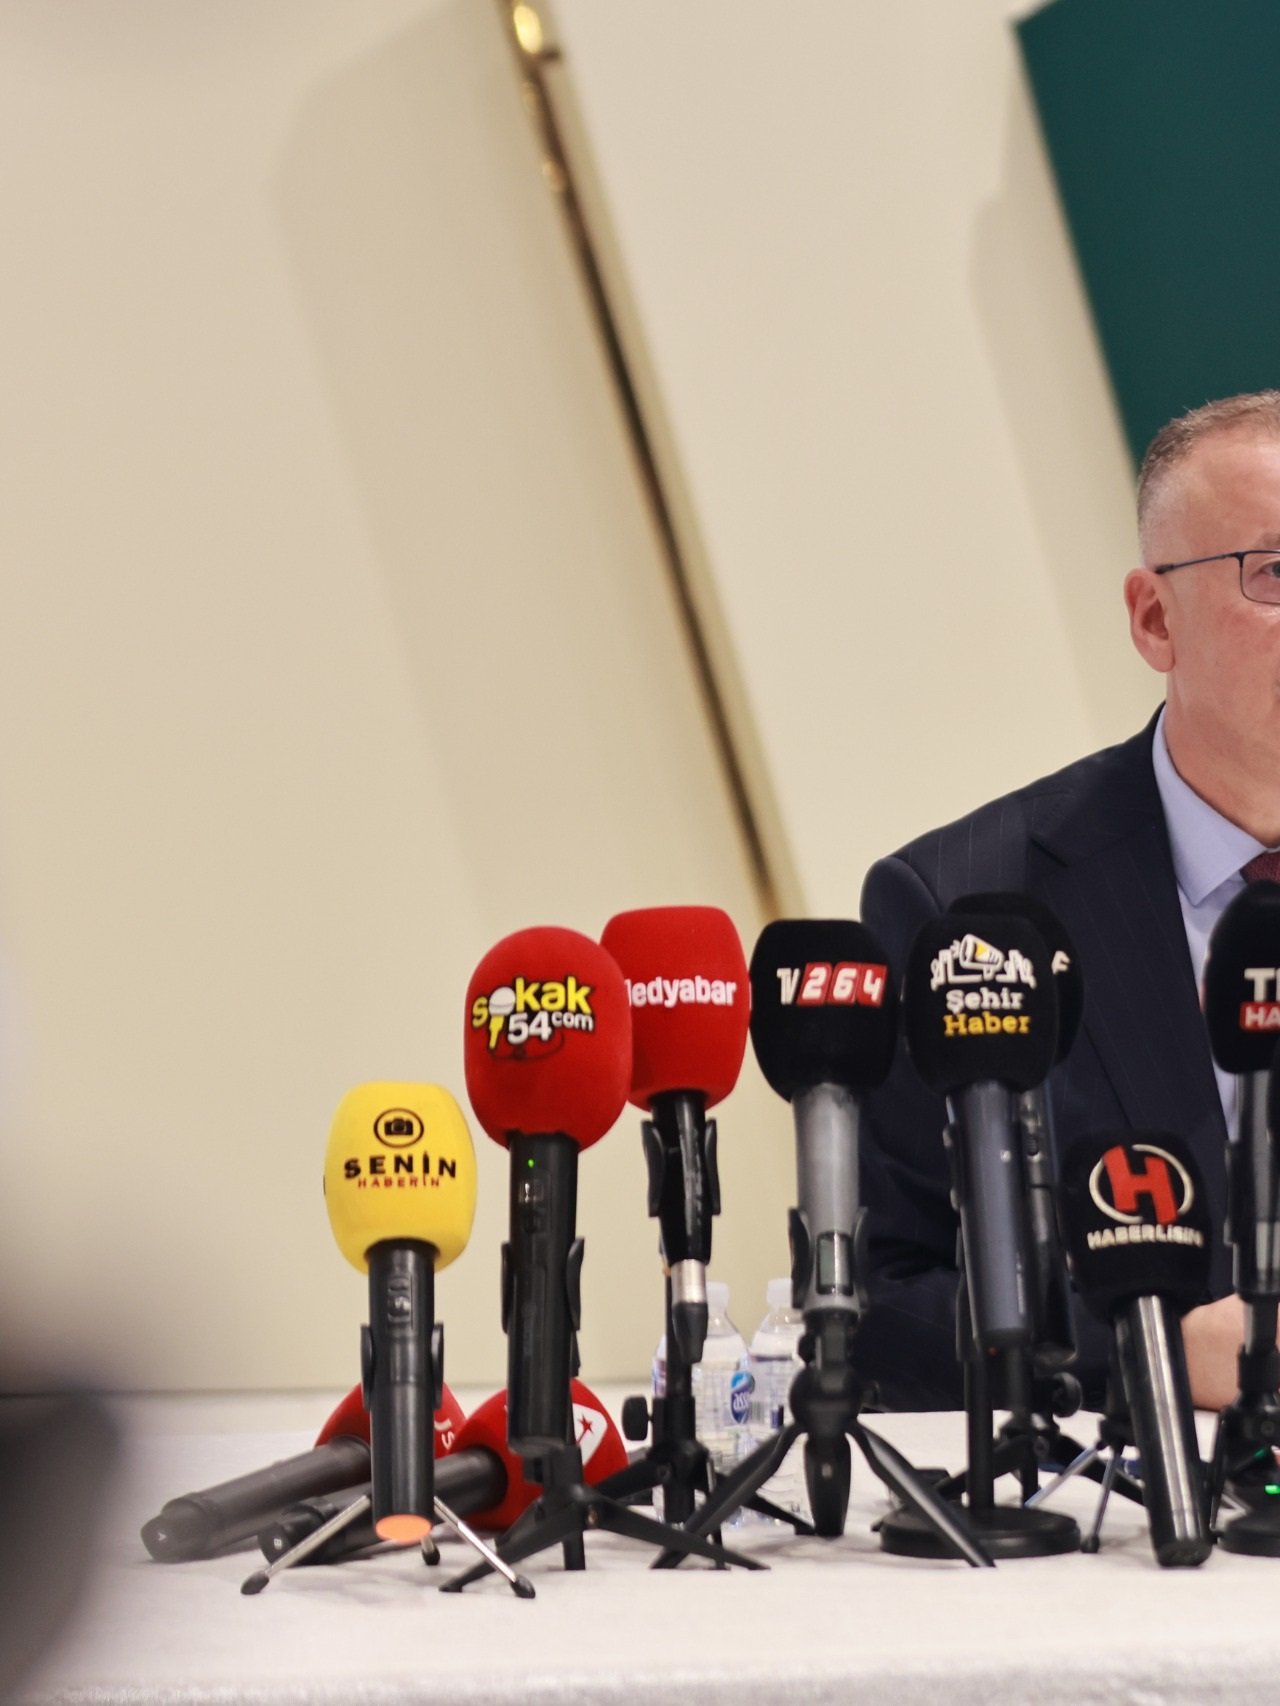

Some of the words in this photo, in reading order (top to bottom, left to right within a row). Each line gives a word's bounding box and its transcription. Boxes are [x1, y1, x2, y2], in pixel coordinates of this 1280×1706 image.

[776, 965, 886, 1006] TV264
[943, 1011, 1031, 1037] Haber
[1103, 1145, 1178, 1226] H
